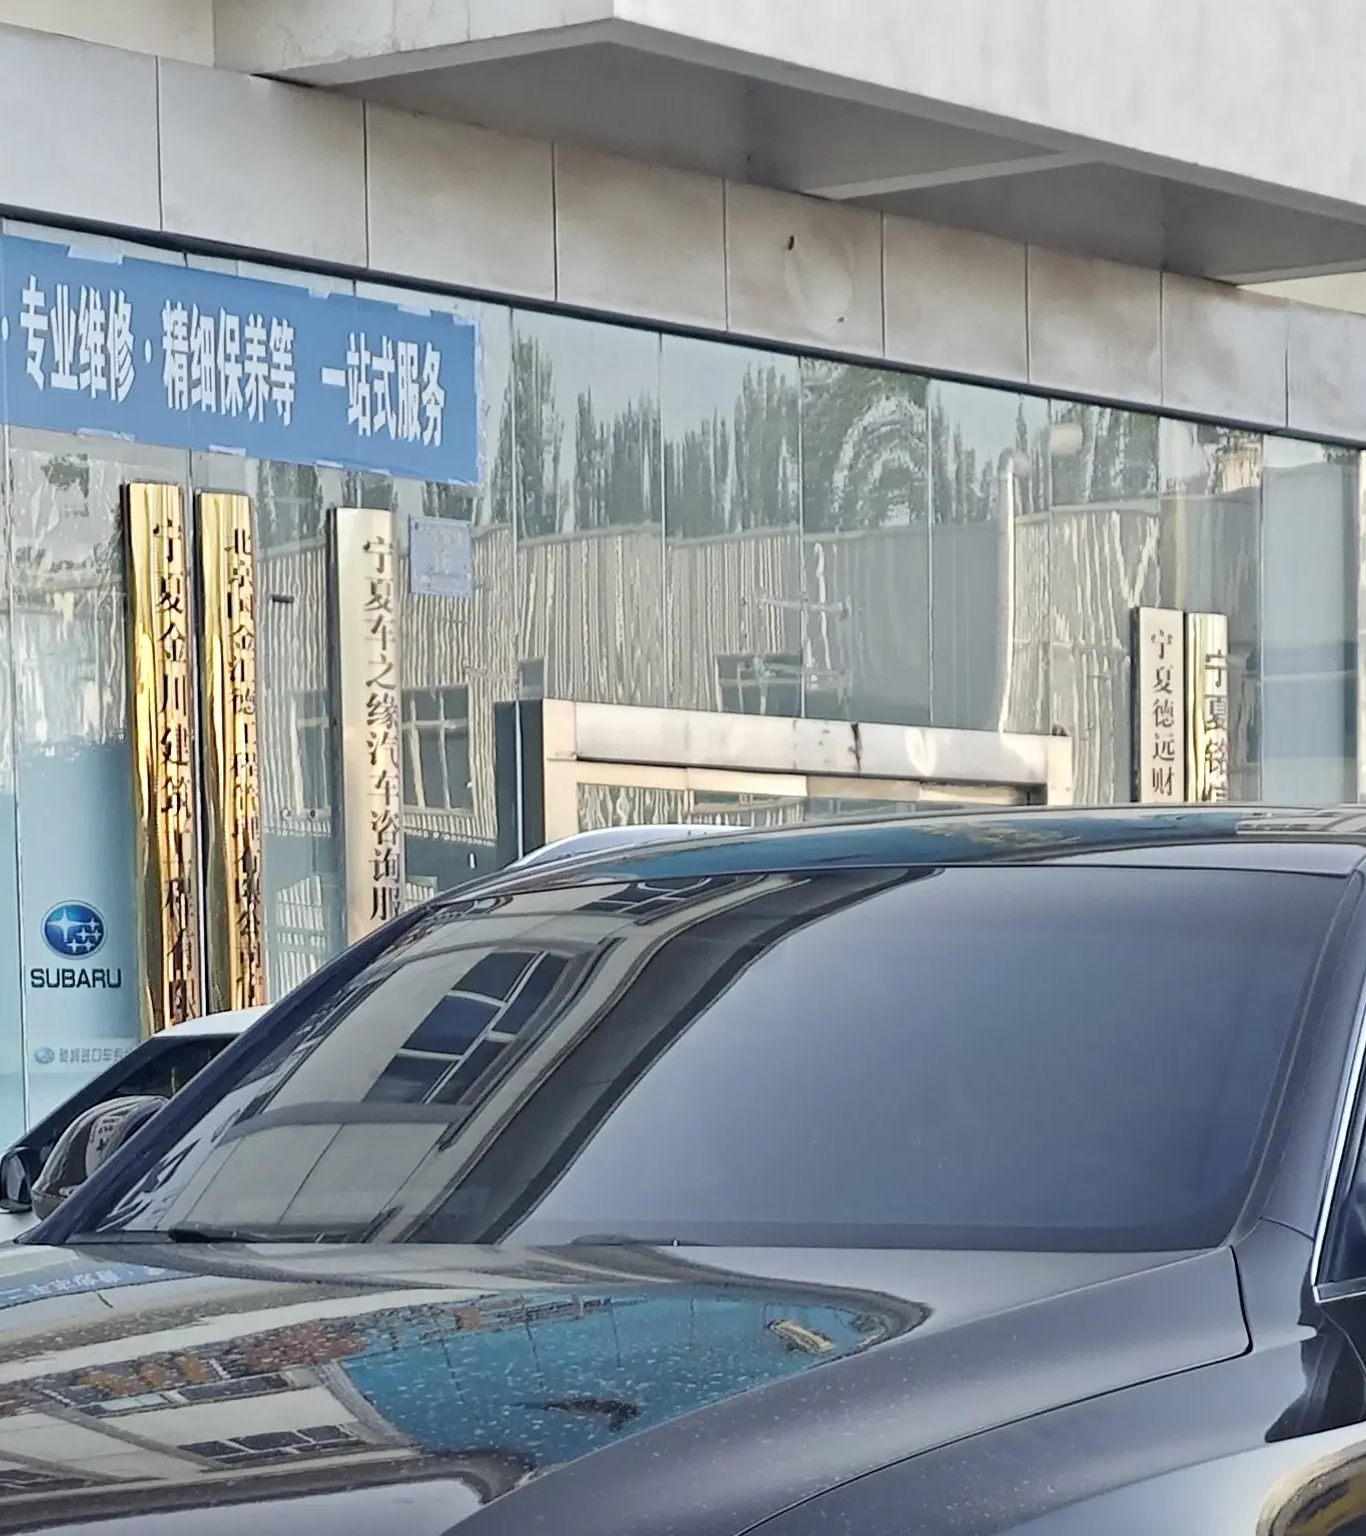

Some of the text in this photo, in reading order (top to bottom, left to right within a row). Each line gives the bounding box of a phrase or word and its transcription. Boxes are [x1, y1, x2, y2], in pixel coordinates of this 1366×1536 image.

[322, 332, 447, 449] 一站式服务
[1151, 628, 1176, 797] 宁夏德远财
[30, 968, 122, 990] SUBARU
